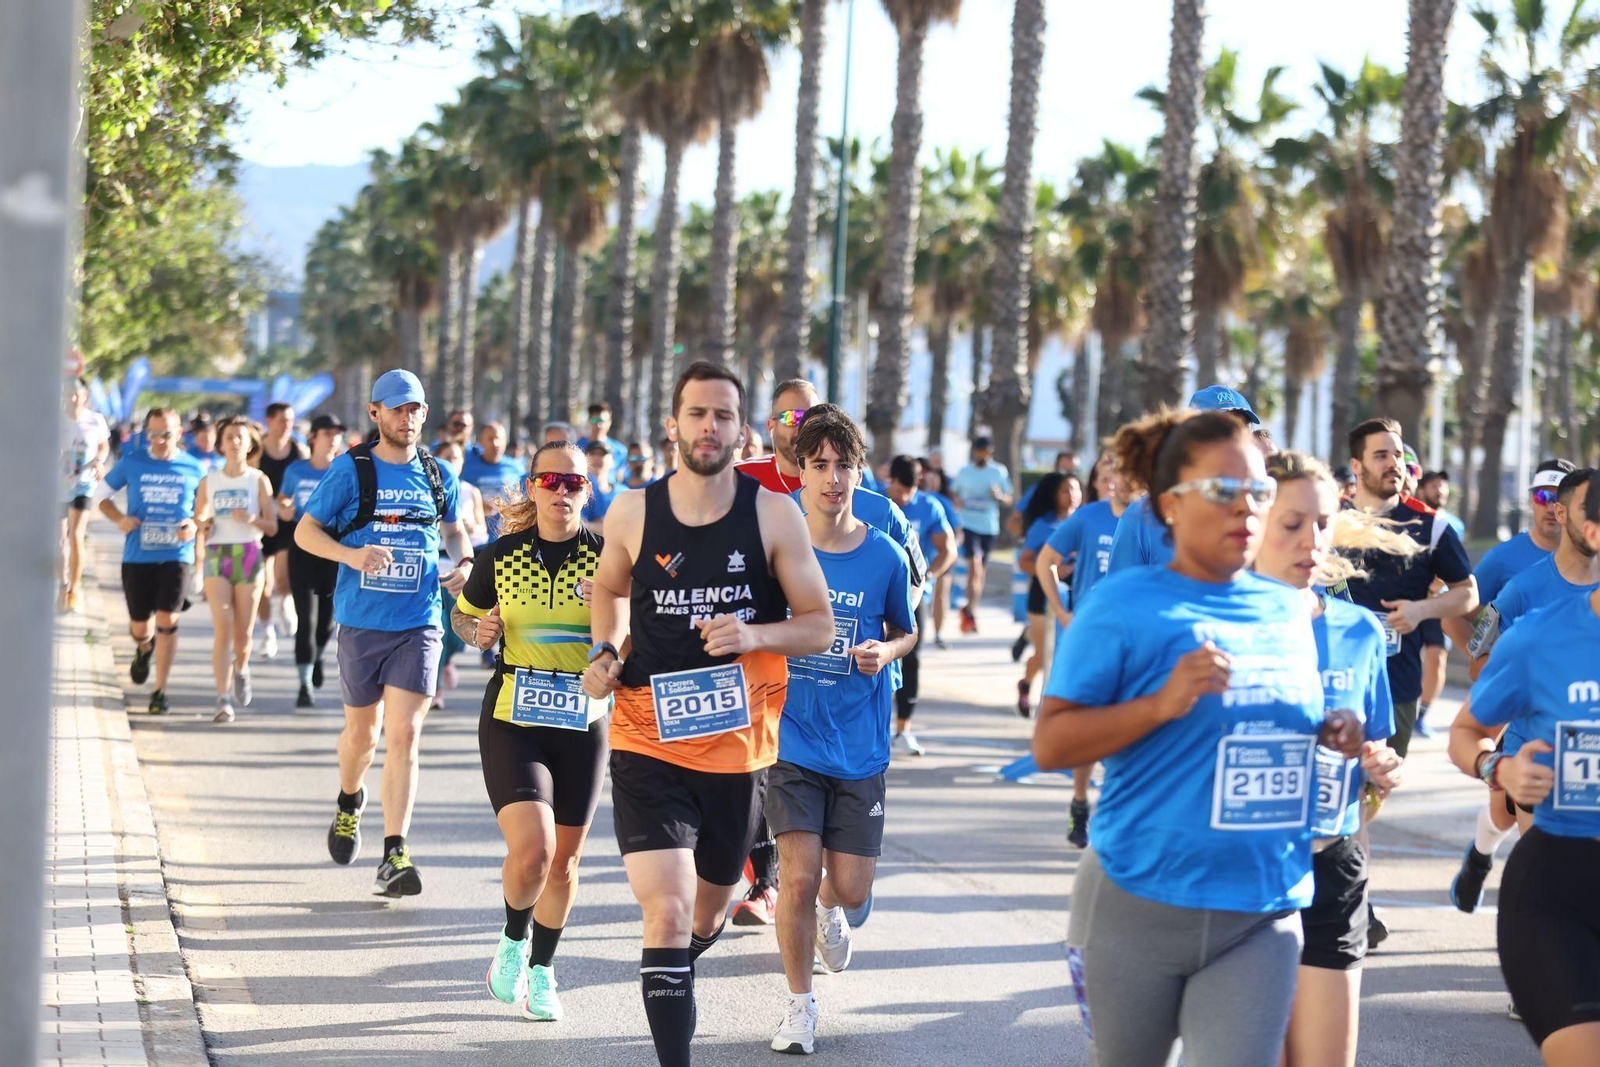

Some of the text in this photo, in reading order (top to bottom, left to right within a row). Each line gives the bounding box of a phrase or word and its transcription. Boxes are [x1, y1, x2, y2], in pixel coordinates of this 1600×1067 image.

[653, 584, 753, 606] VALENCIA
[828, 589, 864, 607] oral
[656, 605, 714, 615] MAKES YOU
[711, 668, 738, 678] mayoral
[528, 680, 554, 688] Solidaria
[668, 684, 700, 694] Solidaria
[1568, 681, 1600, 703] m
[523, 689, 579, 710] 2001
[667, 690, 736, 717] 2015
[1233, 771, 1299, 796] 2199
[648, 989, 687, 998] SPORTLAST
